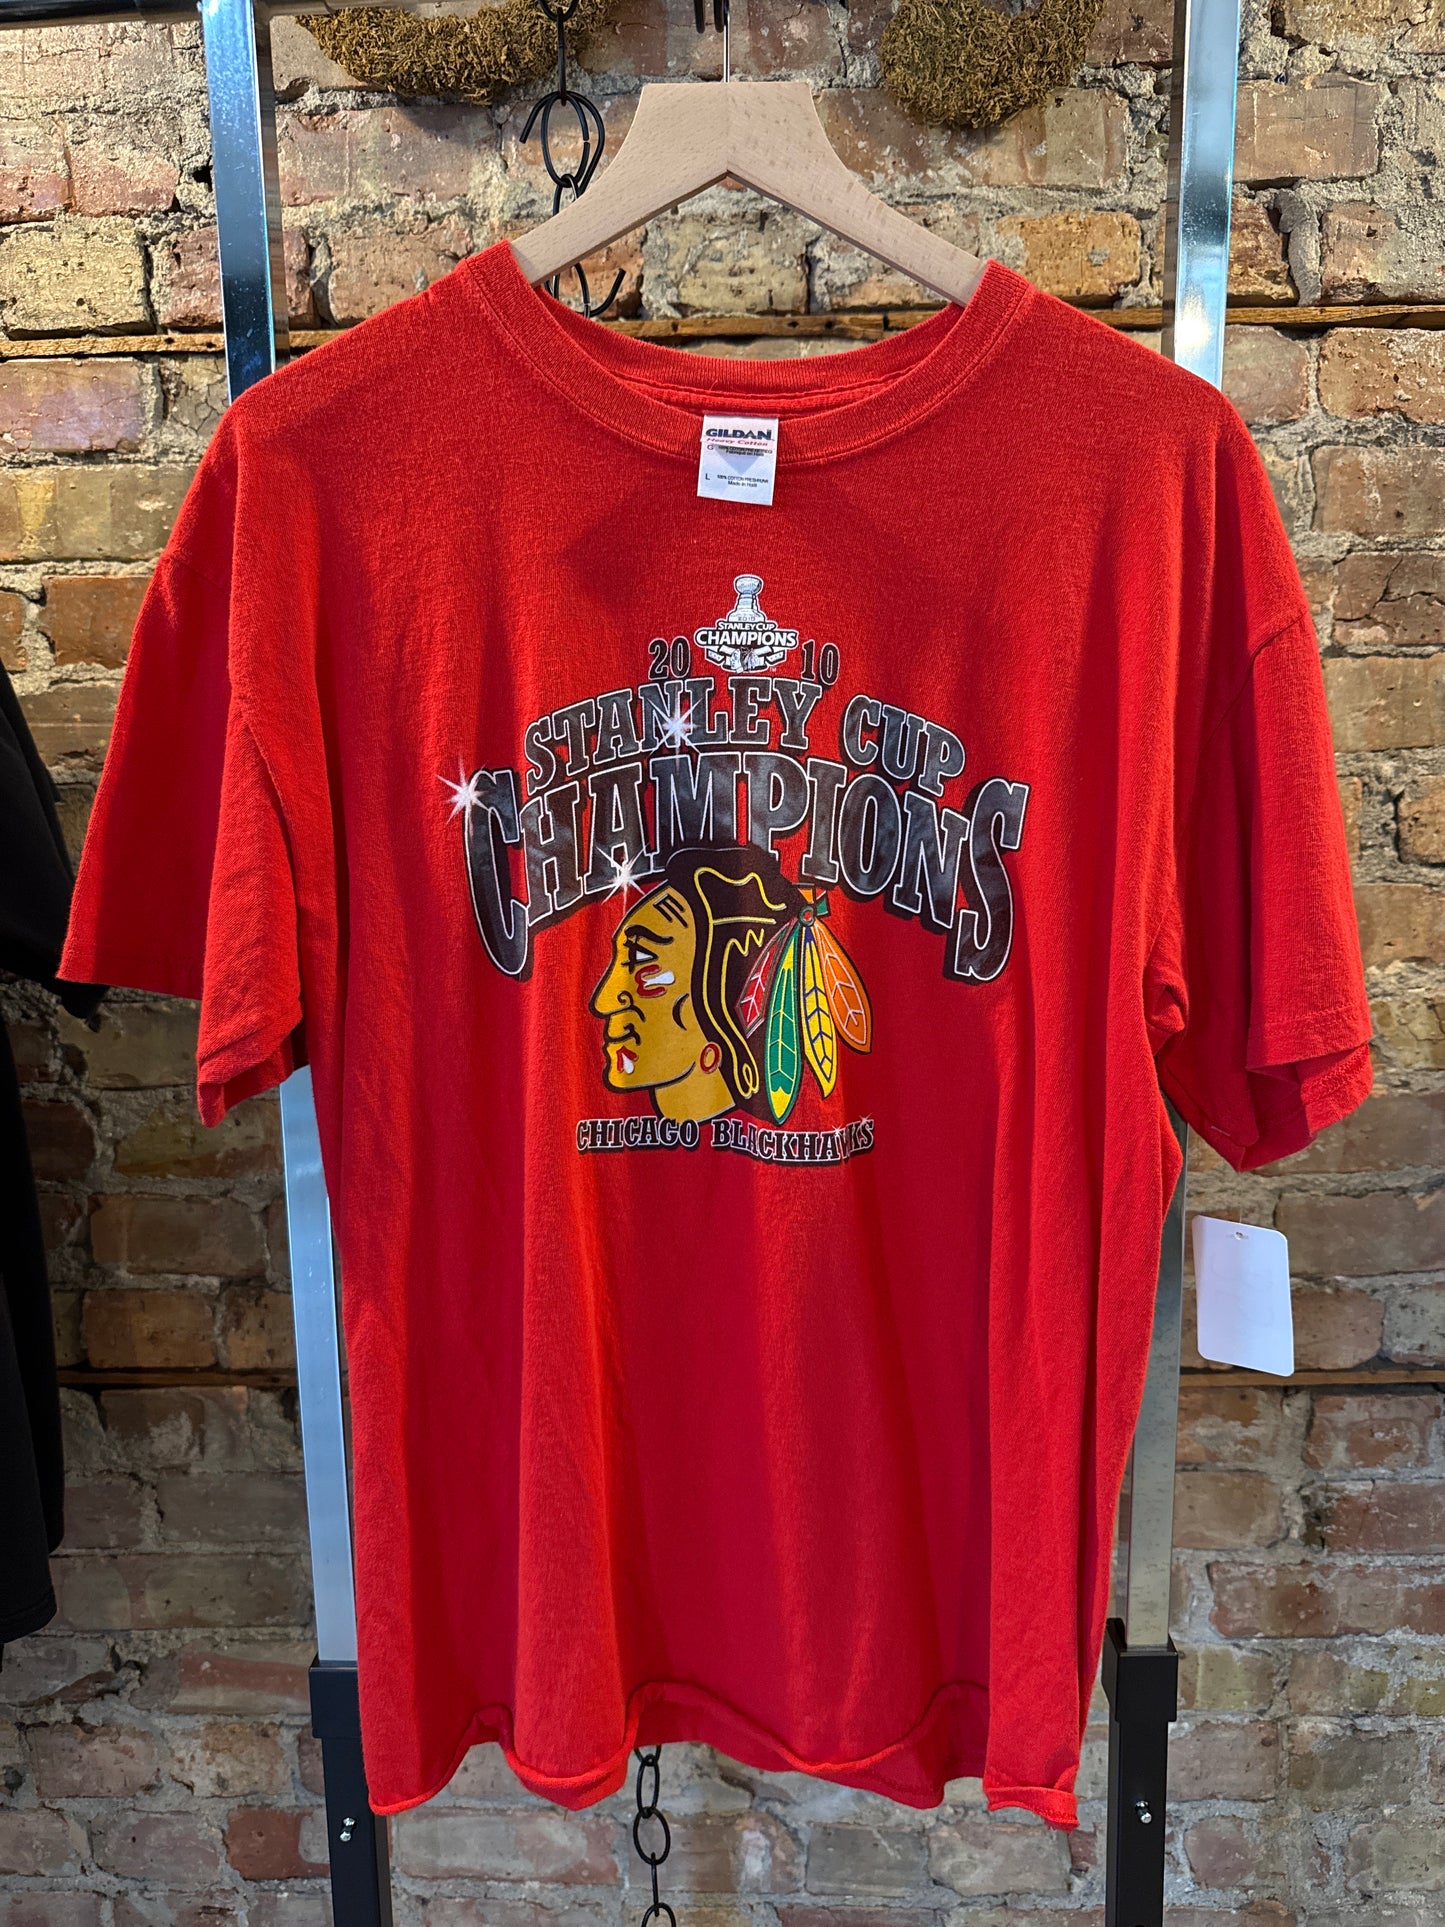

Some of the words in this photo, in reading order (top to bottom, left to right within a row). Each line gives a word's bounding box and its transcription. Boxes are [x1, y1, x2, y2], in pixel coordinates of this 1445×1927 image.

[706, 429, 772, 440] GILDAN
[695, 630, 797, 647] CHAMPIONS
[717, 622, 755, 630] STANLEY
[649, 636, 690, 679] 20
[801, 639, 840, 685] 10
[525, 677, 822, 796] STANLEY
[844, 695, 965, 797] CUP
[464, 751, 1030, 981] CHAMPIONS
[576, 1116, 699, 1151] CHICAGO
[711, 1119, 874, 1162] BLACKHAWKS
